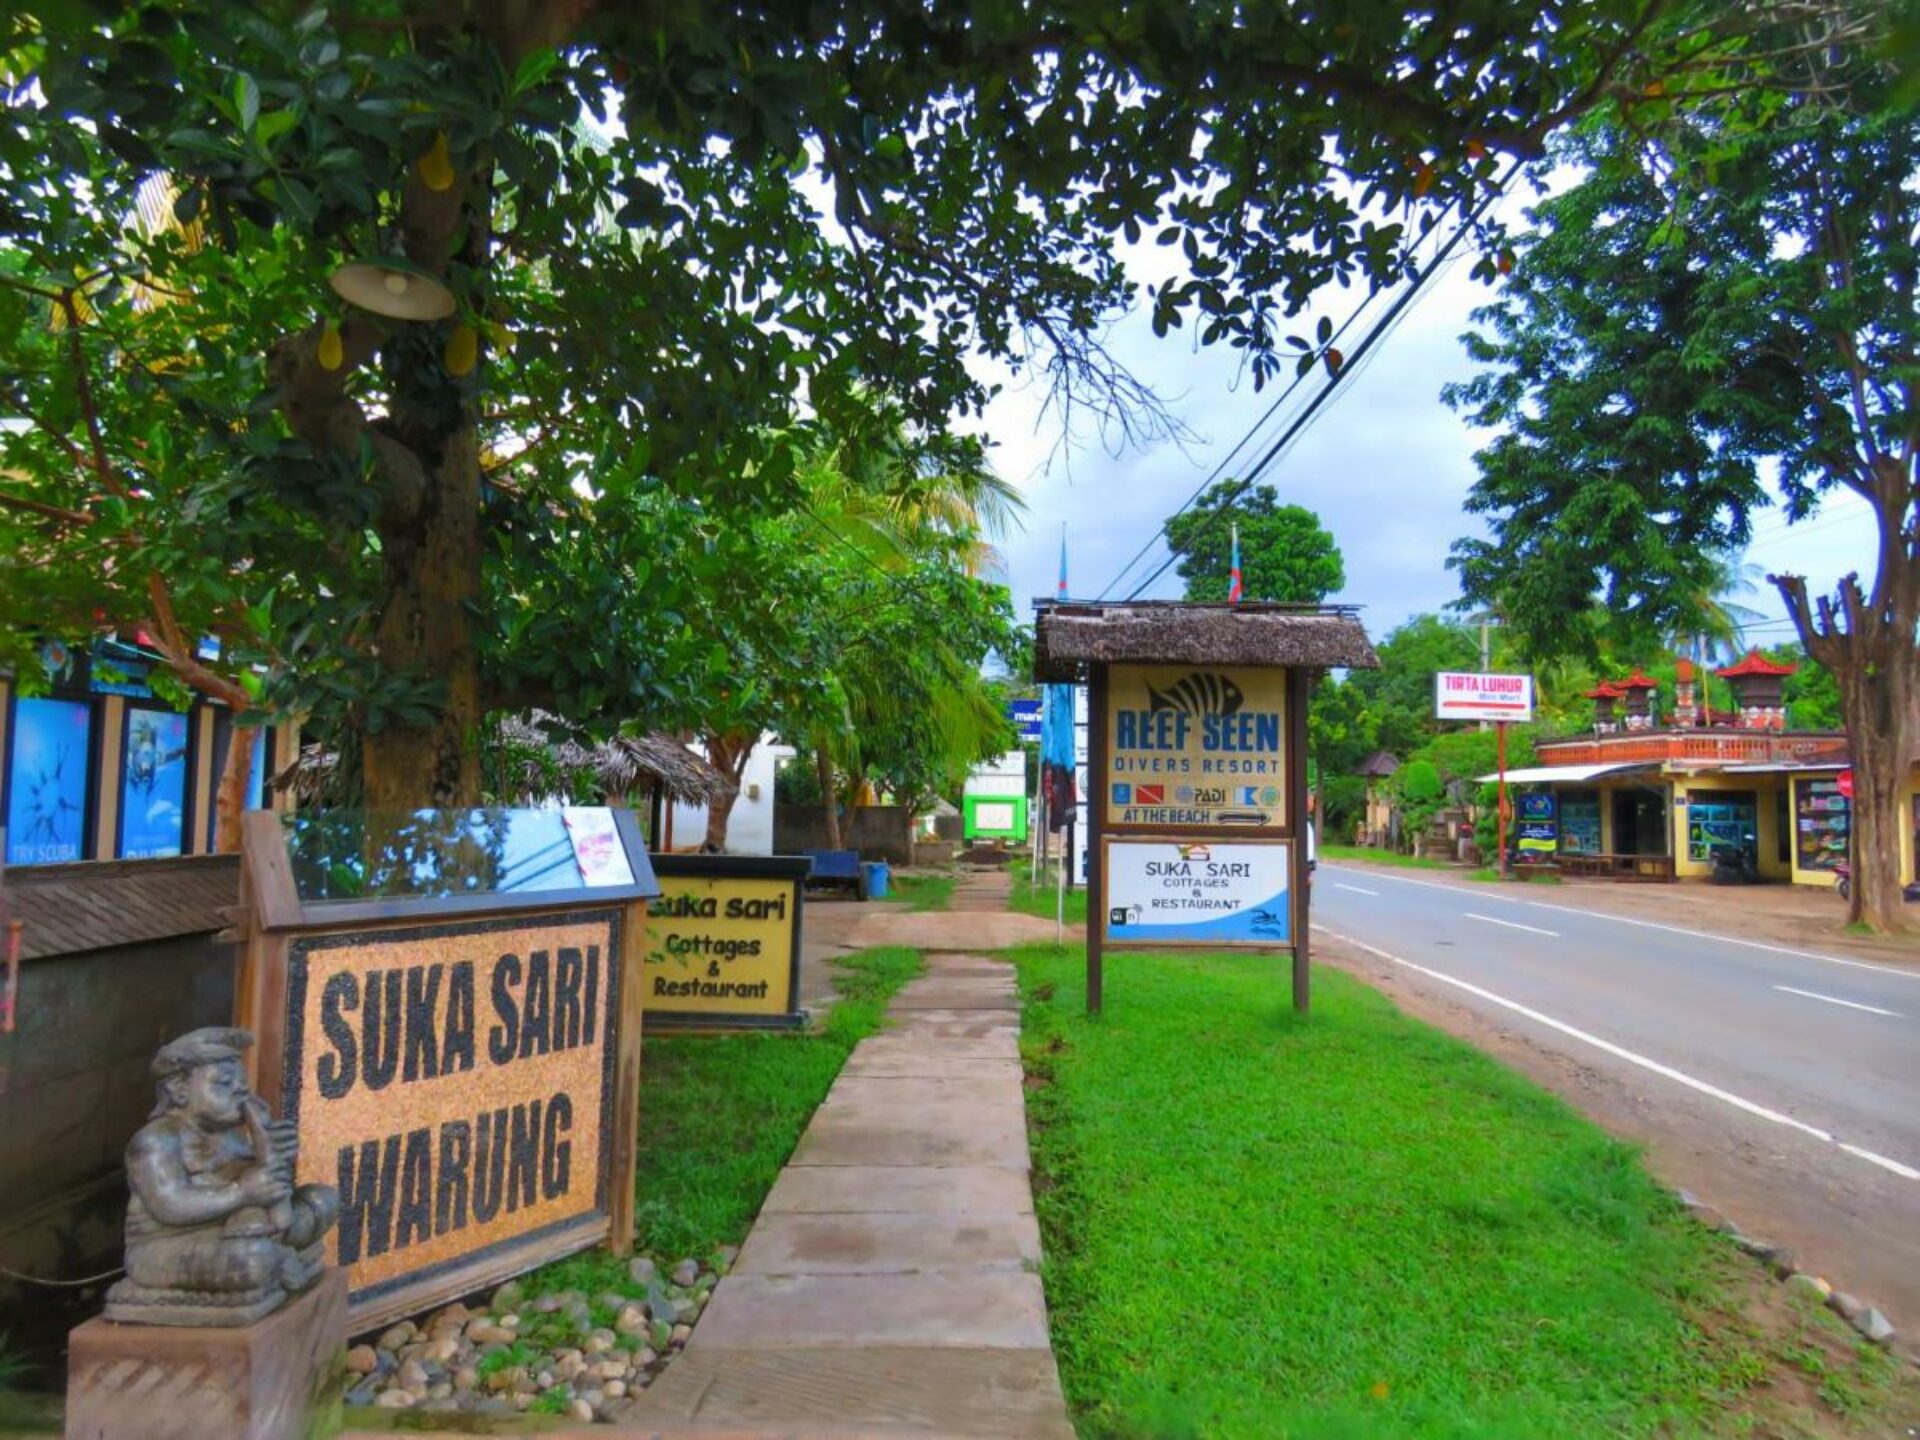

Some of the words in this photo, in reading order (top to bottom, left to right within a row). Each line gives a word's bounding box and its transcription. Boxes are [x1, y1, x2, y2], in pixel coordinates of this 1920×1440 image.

[1445, 676, 1479, 691] TIRTA
[1481, 677, 1522, 692] LUHUR
[1117, 710, 1191, 750] REEF
[1203, 712, 1279, 752] SEEN
[1115, 757, 1190, 772] DIVERS
[1203, 759, 1279, 773] RESORT
[1195, 788, 1226, 803] PADI
[1125, 809, 1140, 823] AT
[1143, 809, 1168, 823] THE
[1169, 809, 1210, 823] BEACH
[39, 844, 77, 862] SCUBA
[1146, 862, 1192, 876] SUKA
[1207, 863, 1251, 878] SARI
[1163, 878, 1229, 888] COTTAGES
[725, 893, 787, 920] sari
[1151, 898, 1242, 910] RESTAURANT
[666, 933, 762, 961] Cottages
[707, 959, 720, 977] &
[654, 975, 769, 999] Restaurant
[316, 959, 476, 1101] SUKA
[488, 944, 601, 1066] SARI
[336, 1092, 574, 1267] WARUNG
